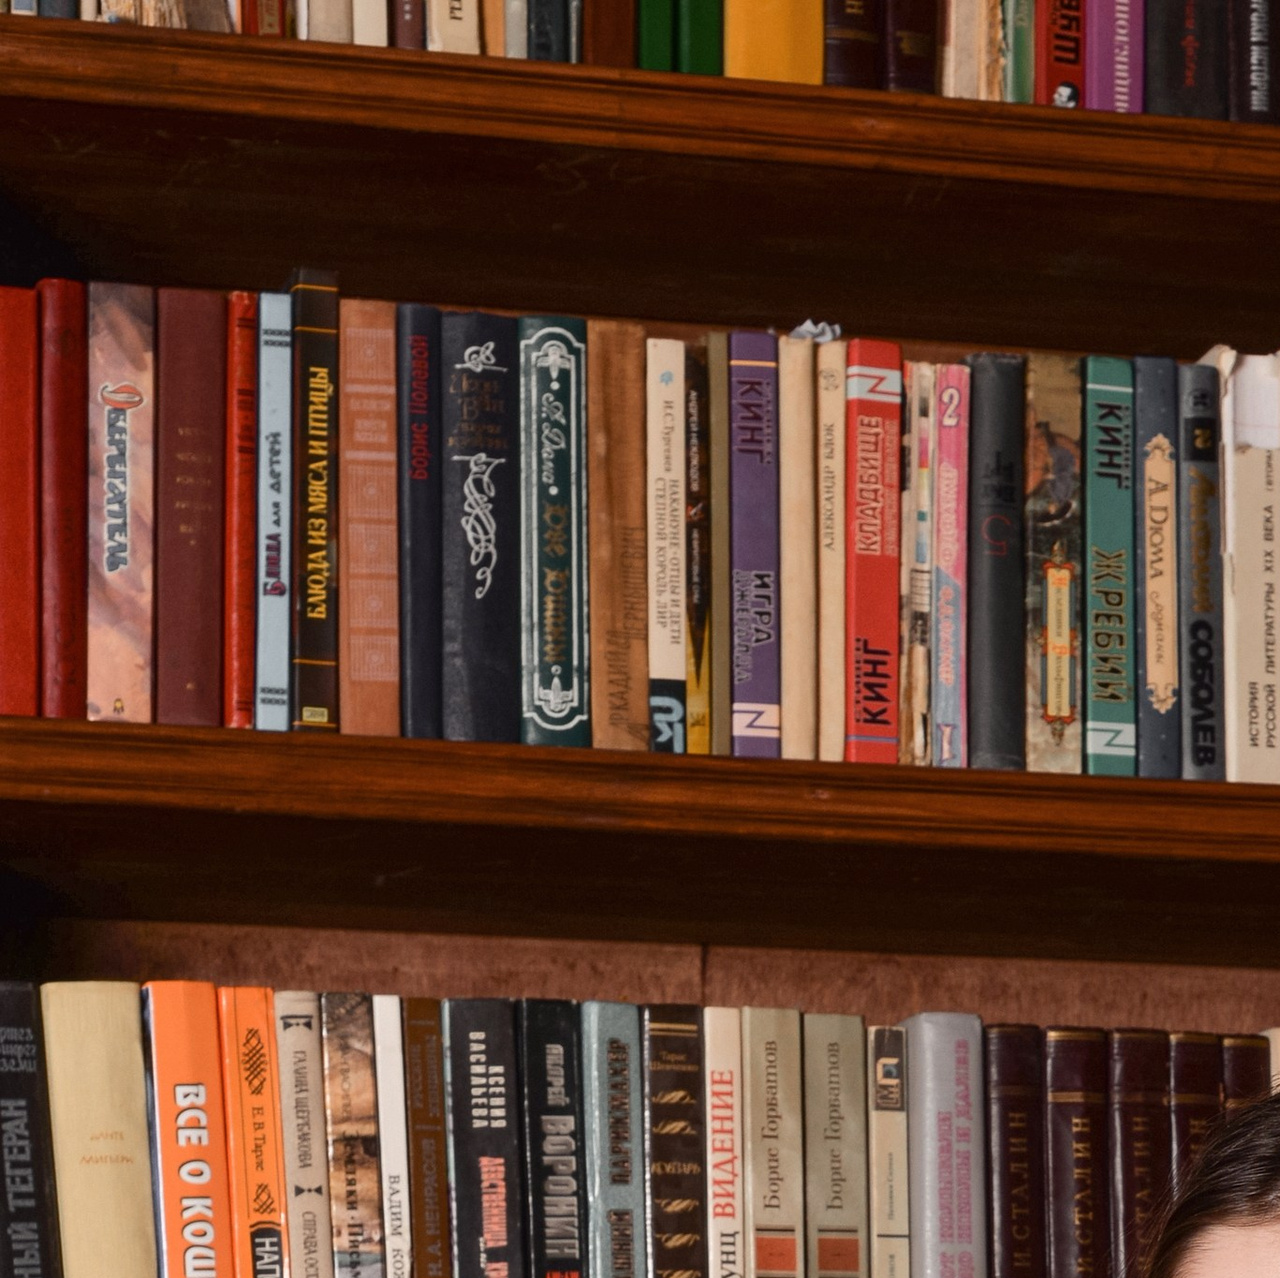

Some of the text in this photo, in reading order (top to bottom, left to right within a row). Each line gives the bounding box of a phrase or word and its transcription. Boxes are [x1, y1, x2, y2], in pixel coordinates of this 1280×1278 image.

[407, 334, 431, 480] Борис Полевой
[735, 378, 766, 466] КИНГ
[1093, 401, 1123, 490] КИНГ
[306, 366, 334, 619] БЛЮДА ИЗ МЯСА И ПТИЦЫ
[822, 421, 837, 552] АЛЕКСАНДР БЛОК
[855, 414, 883, 555] КЛАДБИЩЕ
[1261, 503, 1275, 541] ВЕКА
[751, 570, 774, 647] ИГРА
[1090, 546, 1130, 703] ЖРЕБИЙ
[1262, 581, 1277, 675] ЛИТЕРАТУРЫ
[861, 637, 892, 726] КИНГ
[1189, 619, 1217, 767] СОБОЛЕВ
[1248, 681, 1260, 748] ИСТОРИЯ
[1263, 682, 1277, 749] РУССКОЙ
[173, 1083, 209, 1147] ВСЕ
[291, 1049, 312, 1169] ГАЛИНА ЩЕРБАКОВА
[468, 1030, 488, 1129] ВАСИЛЬЕВА
[488, 1064, 507, 1129] КСЕНИЯ
[607, 1036, 633, 1186] ПАРИКМАХЕР
[760, 1040, 784, 1210] Борис Горбатов
[823, 1041, 847, 1211] Борис Горбатов
[1, 1098, 35, 1213] ТЕГЕРАН
[178, 1159, 211, 1185] О
[340, 1129, 359, 1211] Земляки
[421, 1138, 440, 1236] НЕКРАСОВ
[540, 1043, 580, 1259] АНДРЕЙ ВОРОНИН
[709, 1069, 739, 1219] ВИДЕНИЕ
[300, 1210, 318, 1255] СПРАВА
[387, 1173, 403, 1237] ВАДИМ
